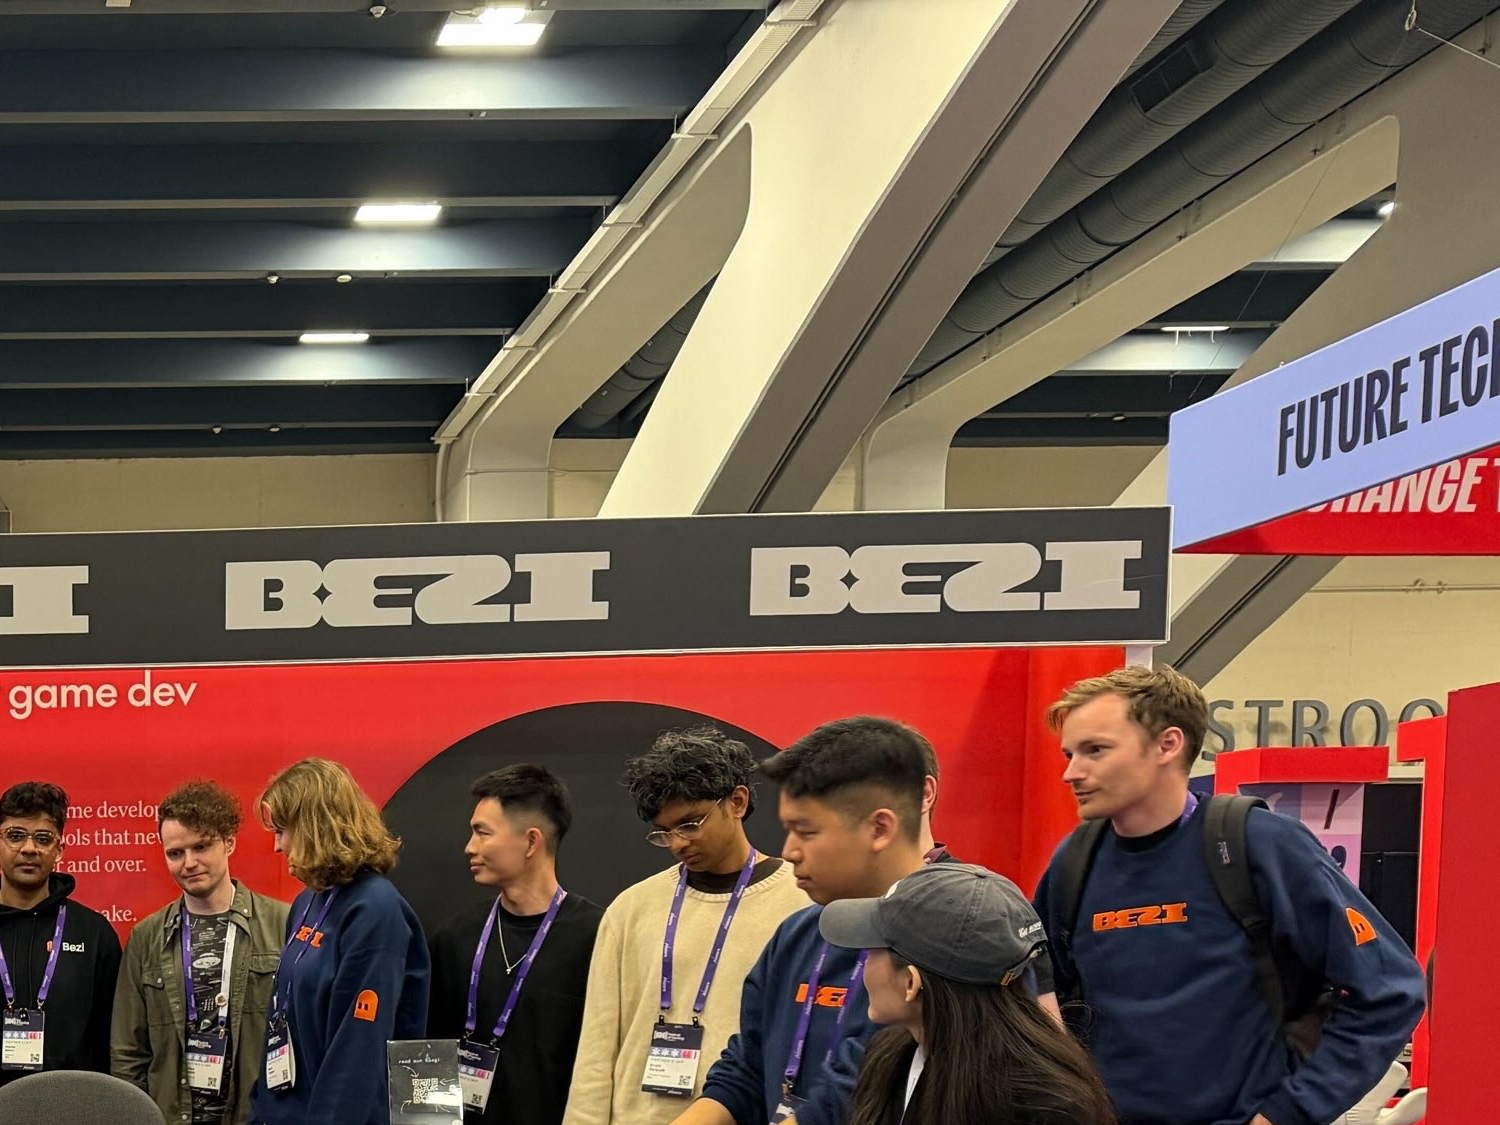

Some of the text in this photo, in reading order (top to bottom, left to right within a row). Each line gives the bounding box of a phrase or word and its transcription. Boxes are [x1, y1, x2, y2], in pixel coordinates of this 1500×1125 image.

[1277, 355, 1411, 477] FUTURE
[1305, 457, 1489, 513] ANGE
[225, 552, 611, 630] BEZI
[750, 540, 1142, 616] BEZI
[8, 680, 118, 721] game
[127, 670, 198, 708] dev
[66, 804, 93, 819] me
[94, 828, 131, 845] that
[67, 856, 100, 872] and
[104, 859, 147, 873] over.
[101, 905, 137, 921] ake.
[1093, 902, 1188, 932] BEZI
[62, 942, 85, 953] Bezi
